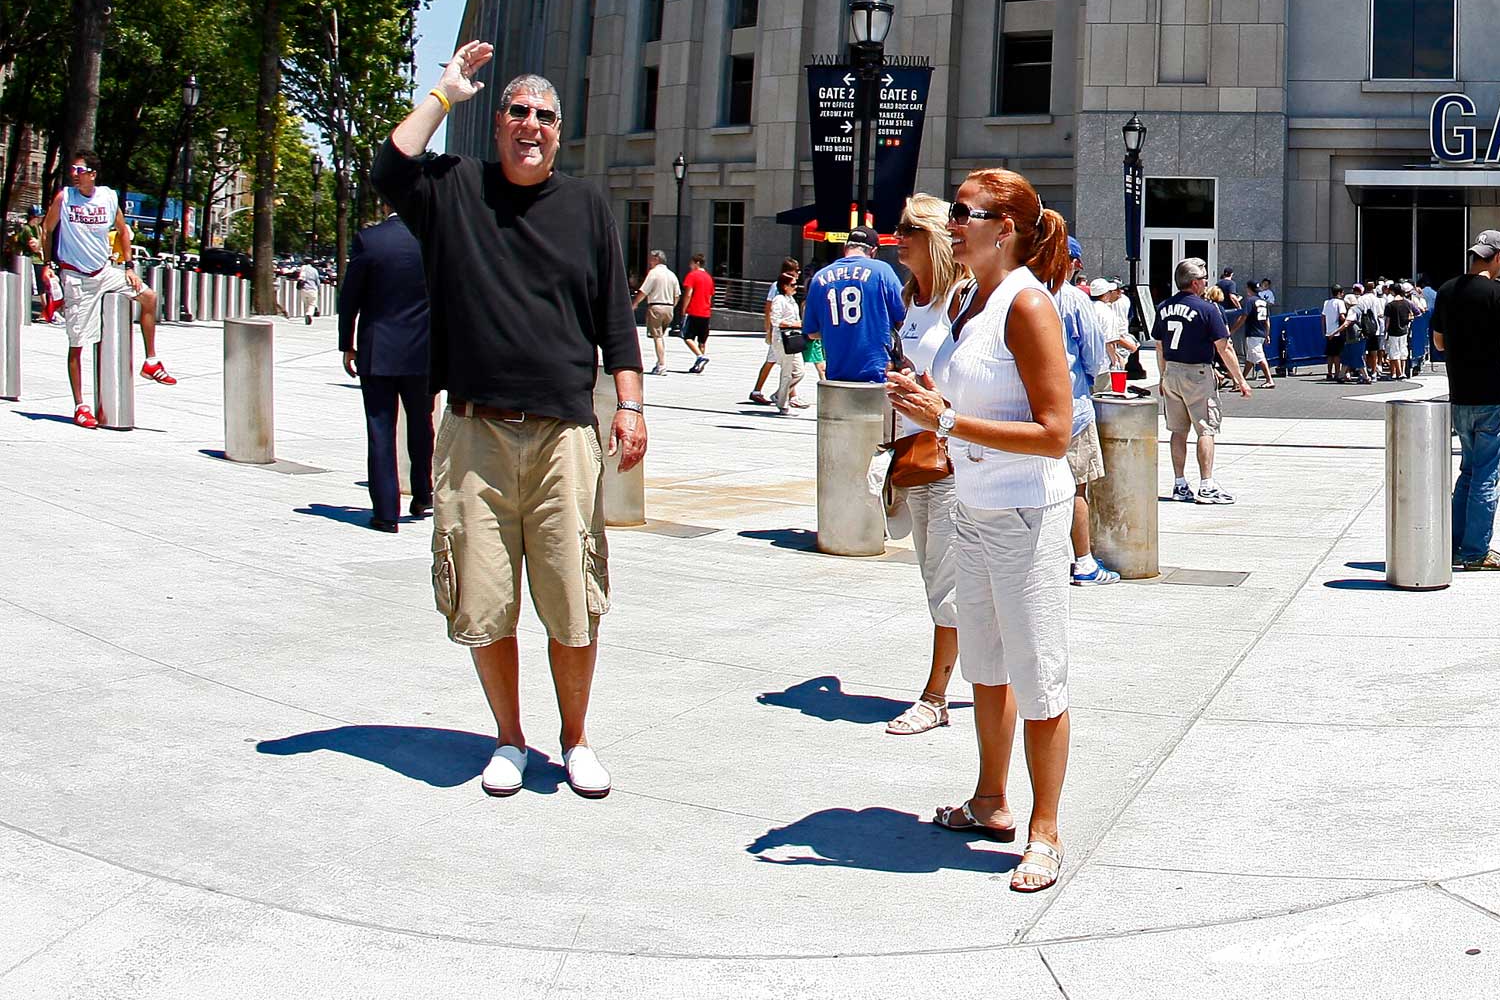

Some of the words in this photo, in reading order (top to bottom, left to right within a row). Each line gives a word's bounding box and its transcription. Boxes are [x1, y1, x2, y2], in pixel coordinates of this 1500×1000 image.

[882, 55, 930, 67] STADIUM
[818, 87, 846, 100] GATE
[848, 87, 856, 100] 2
[880, 88, 908, 101] GATE
[910, 89, 918, 101] 6
[895, 119, 914, 127] STORE
[877, 128, 903, 136] SUBWAY
[818, 266, 872, 287] KAPLER
[827, 286, 862, 326] 18
[1159, 303, 1198, 322] MANTLE
[1167, 320, 1184, 350] 7
